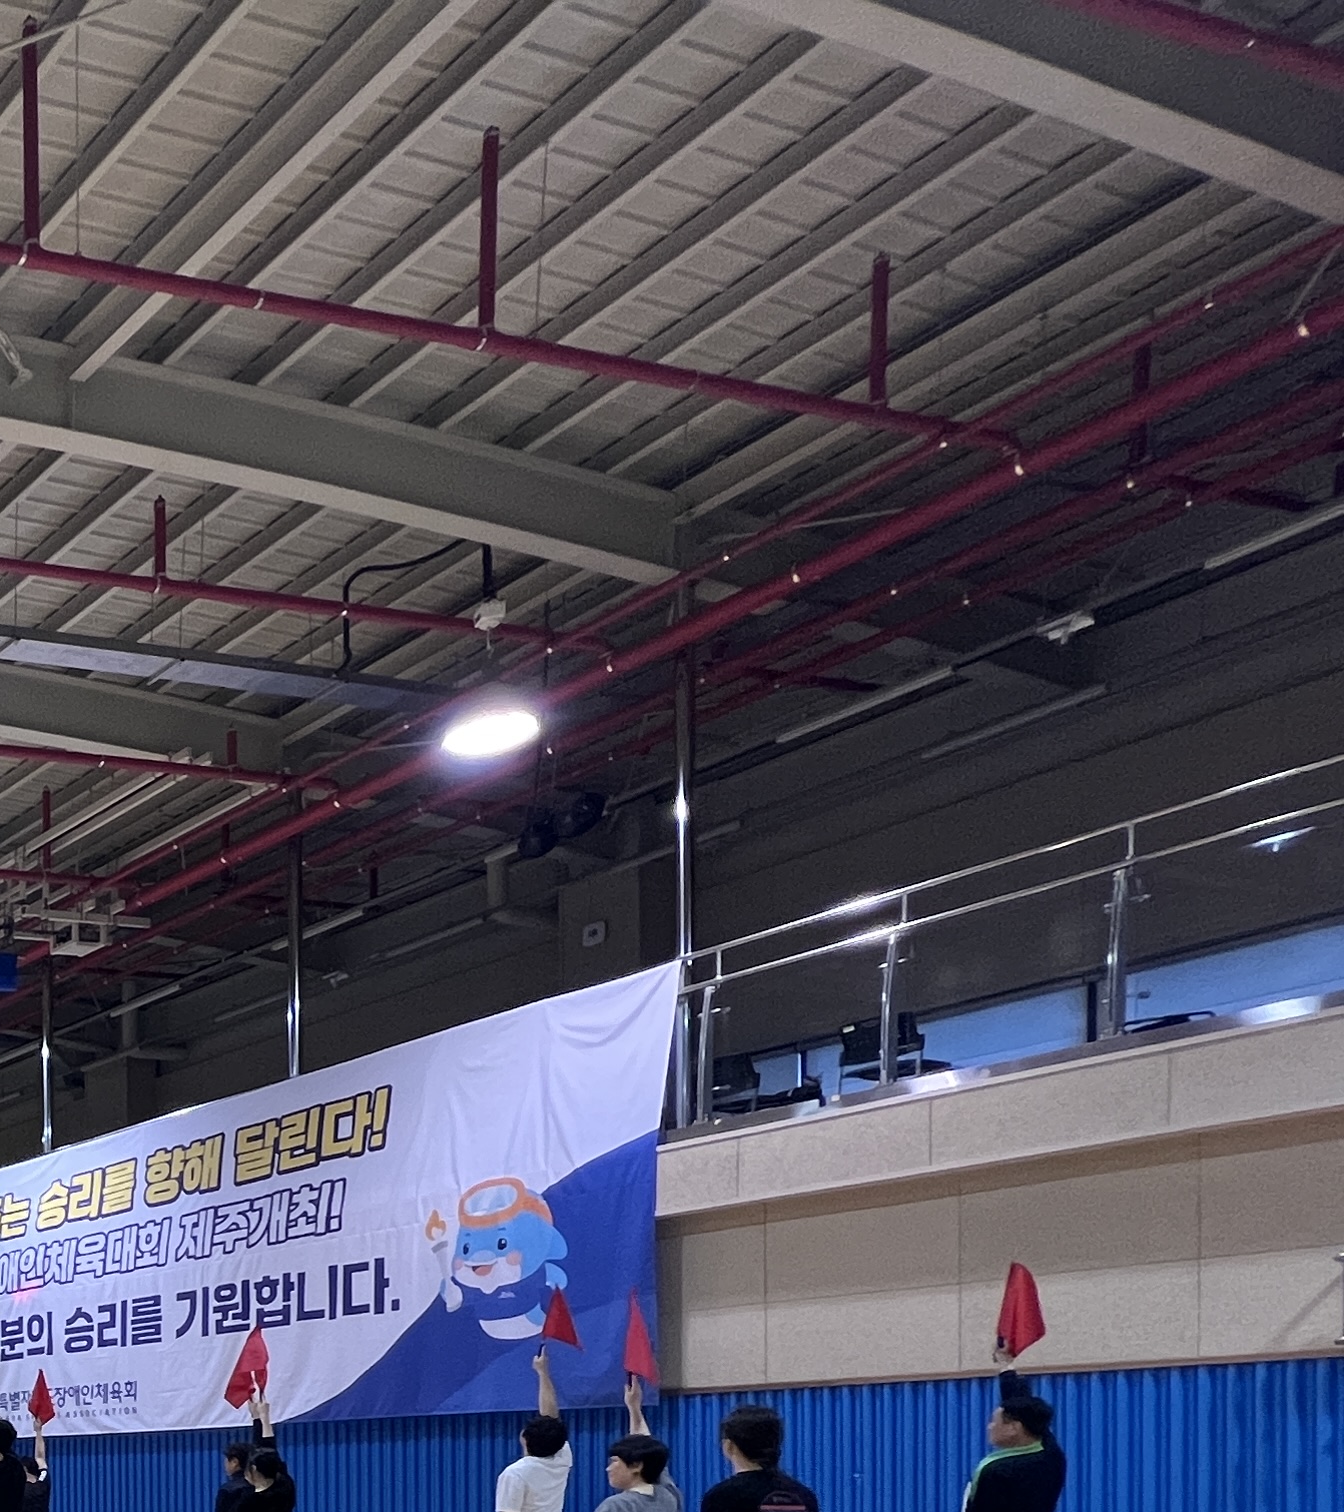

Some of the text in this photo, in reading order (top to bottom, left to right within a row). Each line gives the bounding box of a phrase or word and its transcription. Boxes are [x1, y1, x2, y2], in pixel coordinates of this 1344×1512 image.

[36, 1158, 138, 1233] 승리를
[144, 1132, 226, 1207] 향해
[234, 1085, 393, 1186] 달린다!
[175, 1178, 347, 1262] 제주개최!
[64, 1295, 163, 1354] 승리를
[175, 1257, 401, 1338] 기원합니다.
